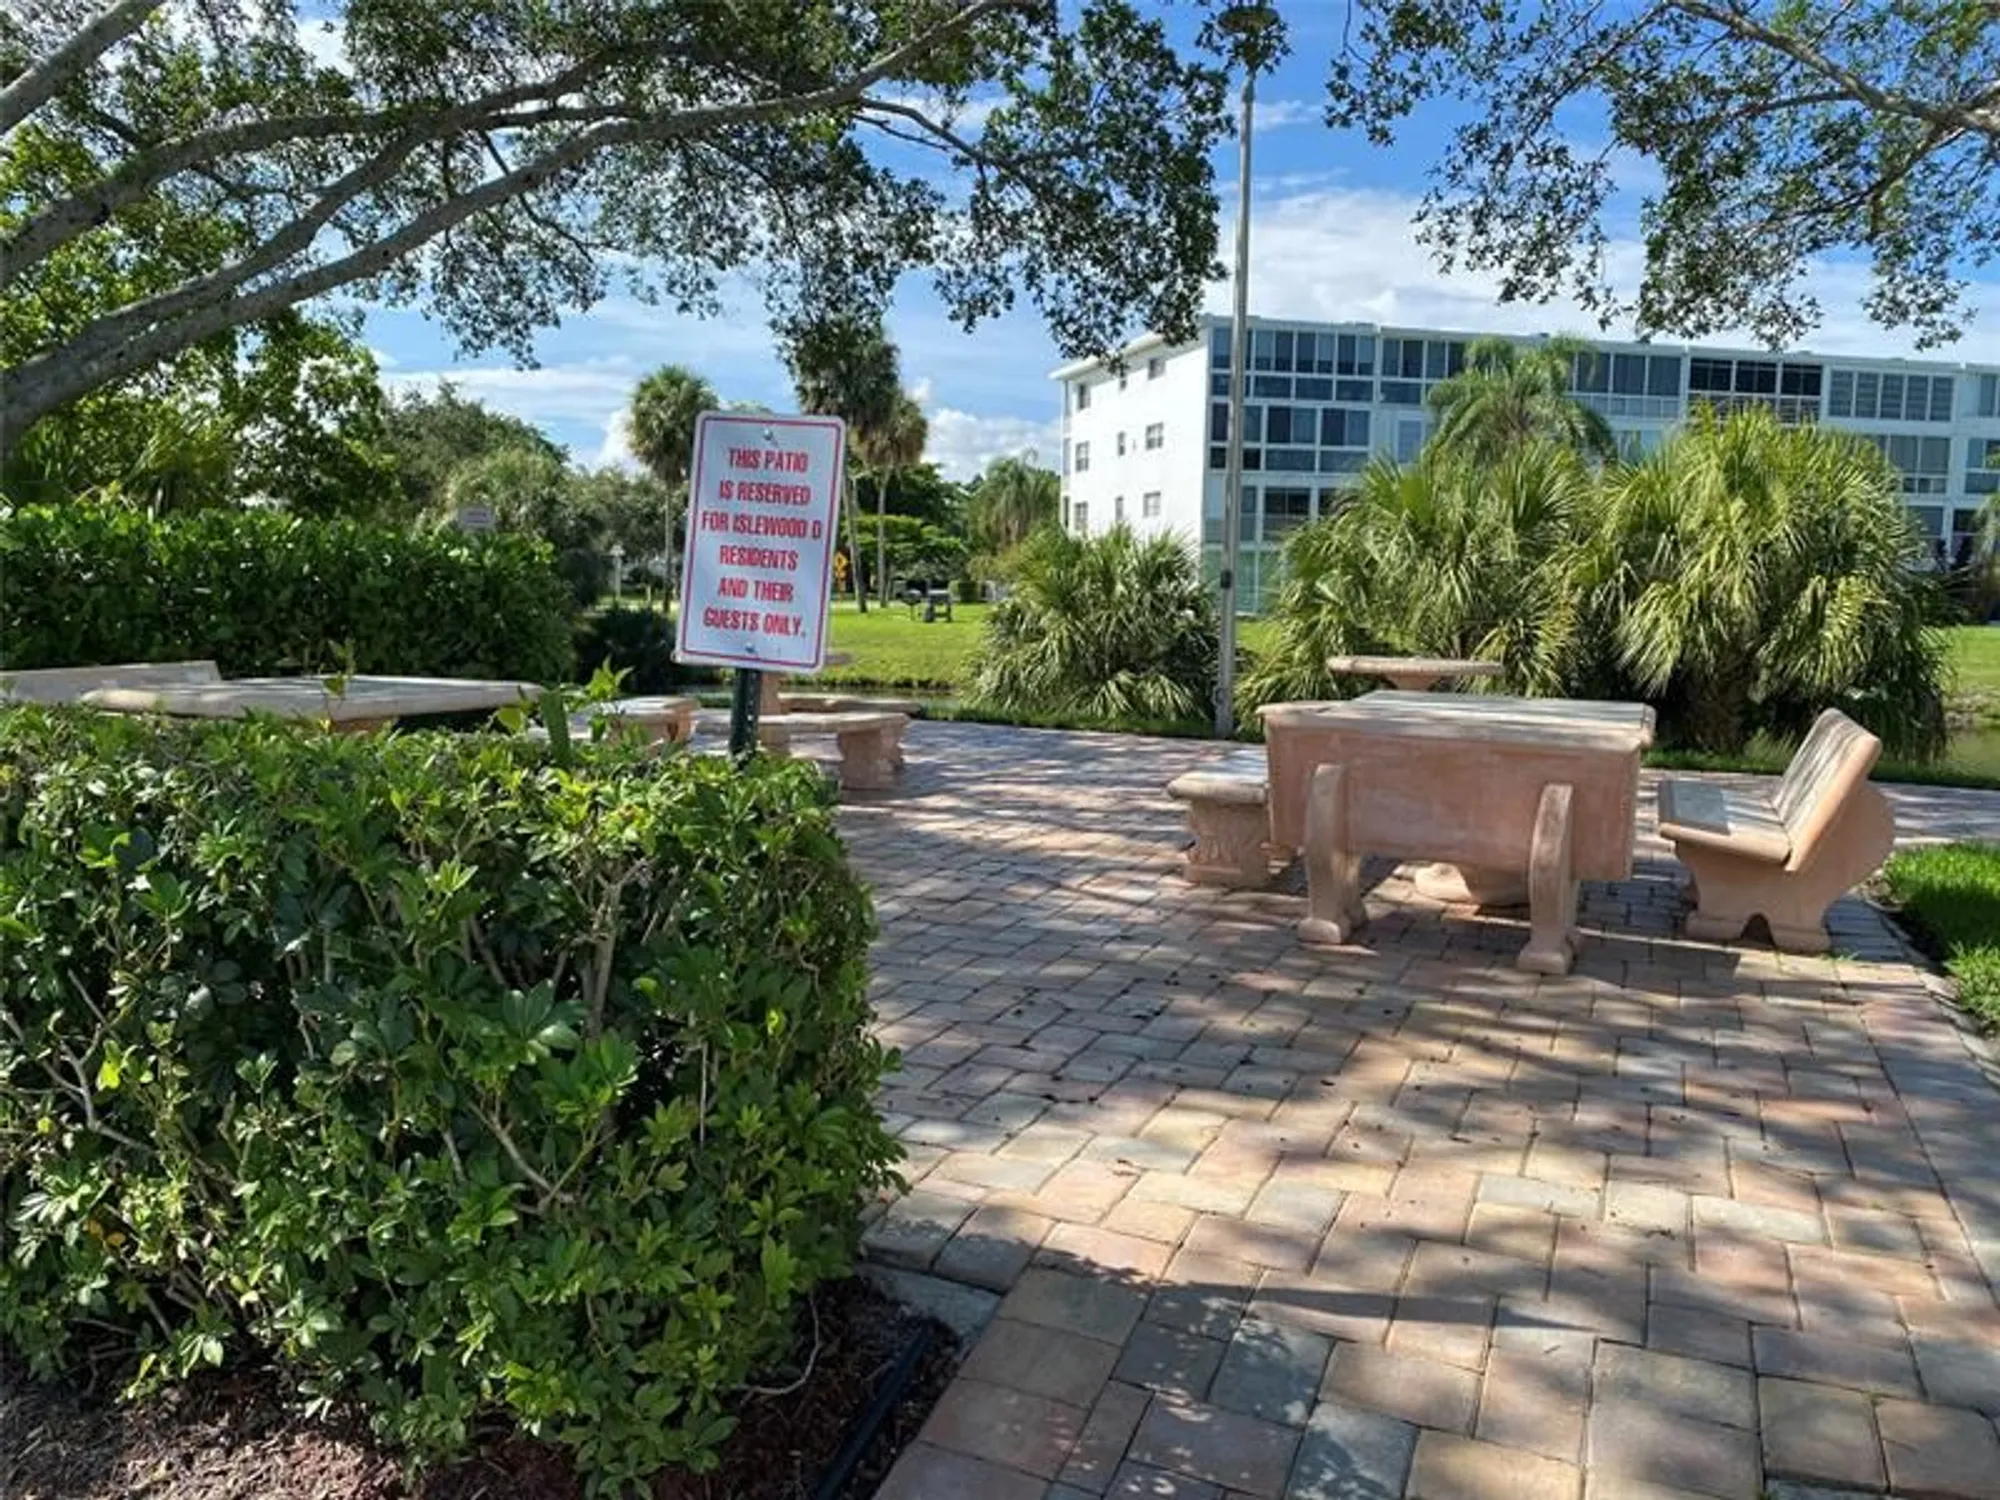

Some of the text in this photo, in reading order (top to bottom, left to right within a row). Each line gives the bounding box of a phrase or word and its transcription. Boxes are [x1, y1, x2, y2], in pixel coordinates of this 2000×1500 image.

[728, 447, 809, 473] THIS PATIO
[720, 479, 811, 506] IS RESERVED
[701, 510, 729, 532] FOR
[732, 512, 808, 539] ISLEWOOD
[719, 544, 799, 571] RESIDENTS
[717, 577, 794, 603] AND THEIR
[702, 606, 760, 632] GUESTS
